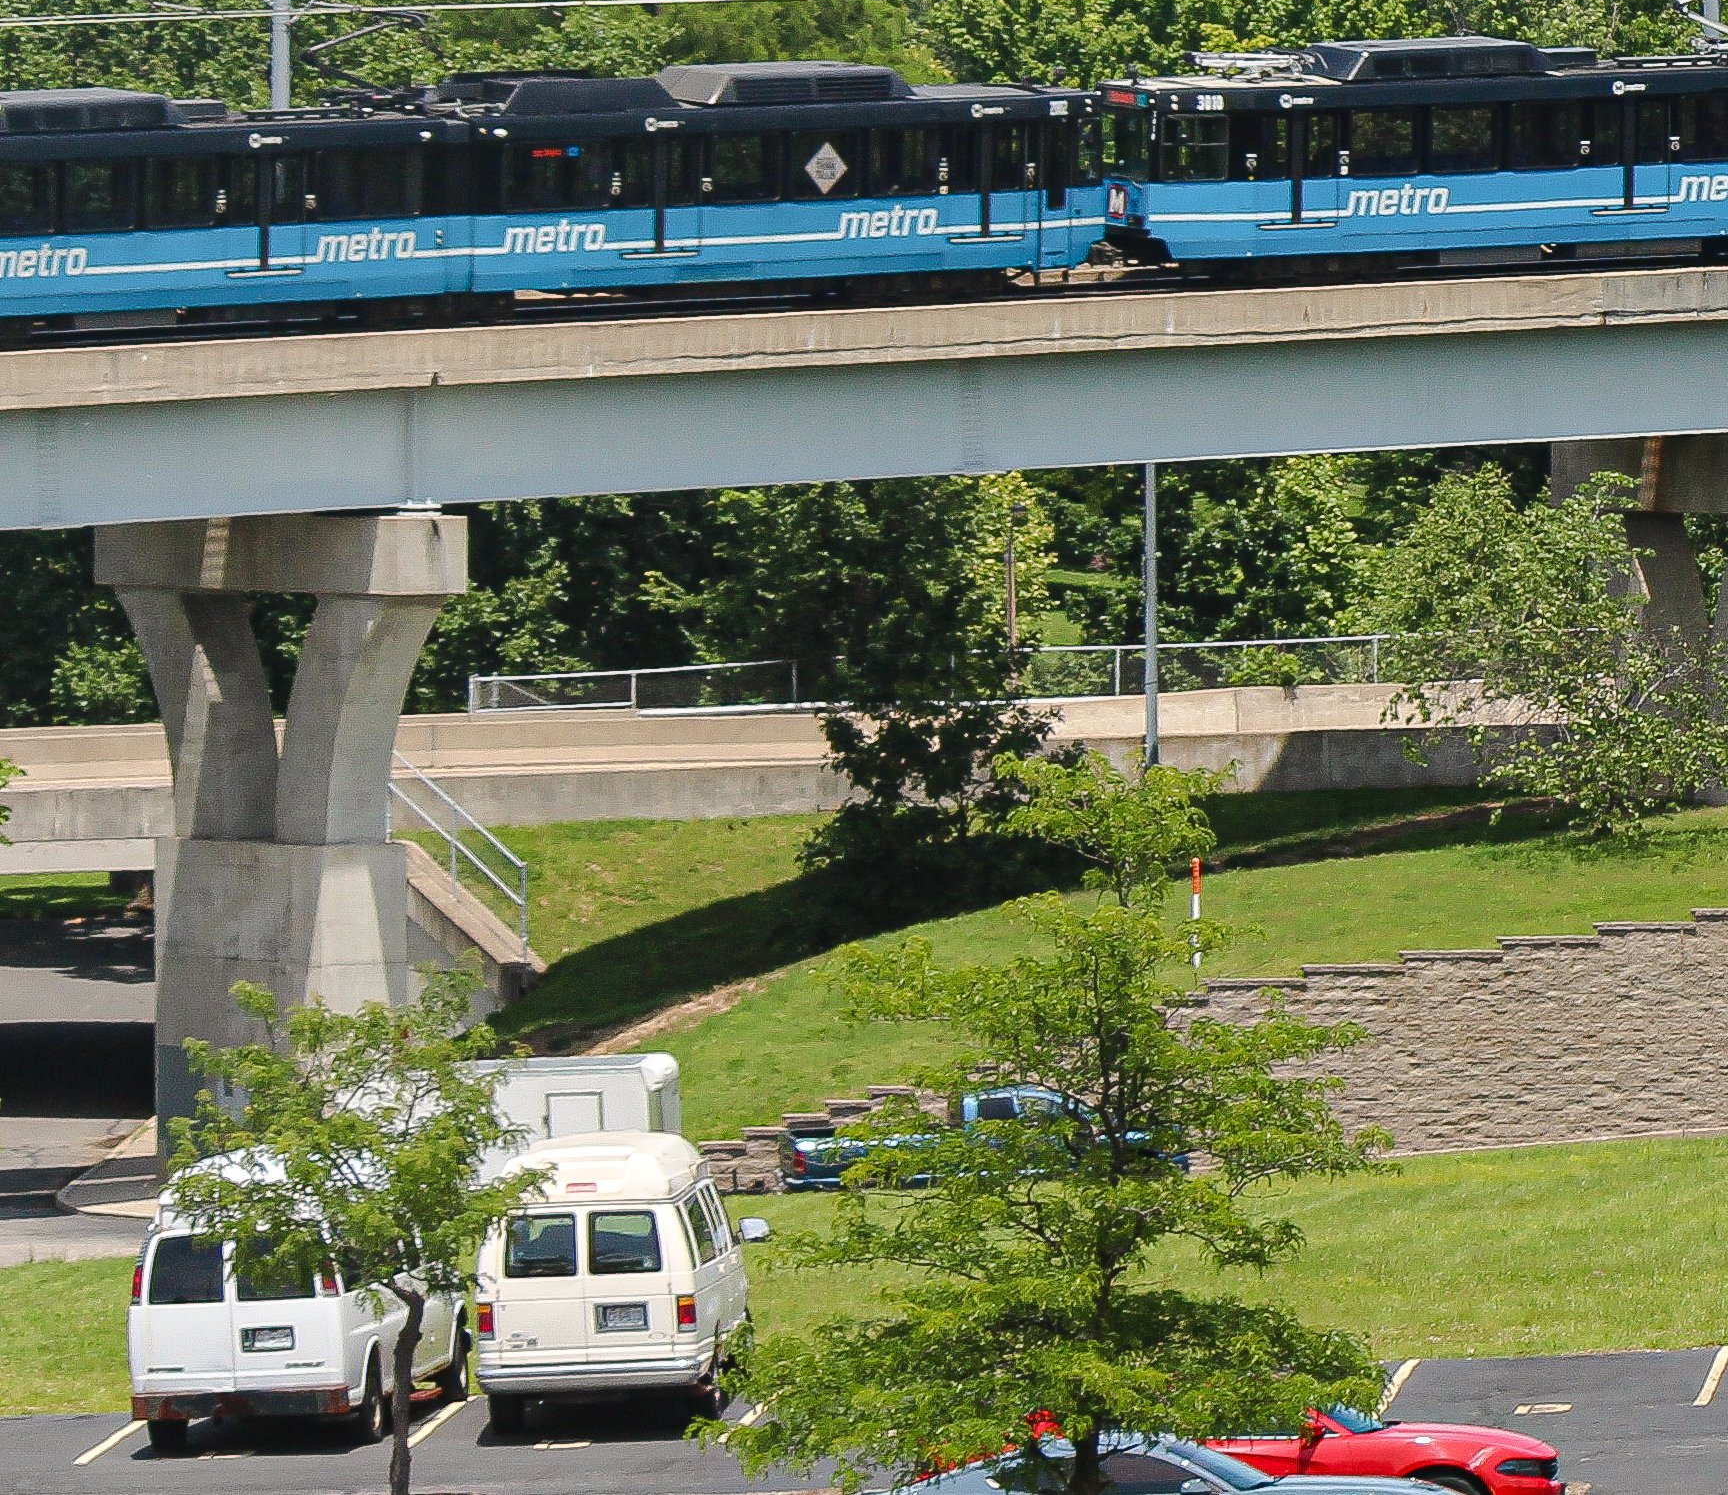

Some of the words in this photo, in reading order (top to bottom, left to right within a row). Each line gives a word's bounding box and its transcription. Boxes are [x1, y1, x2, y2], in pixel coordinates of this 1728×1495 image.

[1348, 183, 1449, 216] metro
[504, 218, 605, 254] metro
[839, 204, 938, 239] metro
[317, 227, 416, 262] metro
